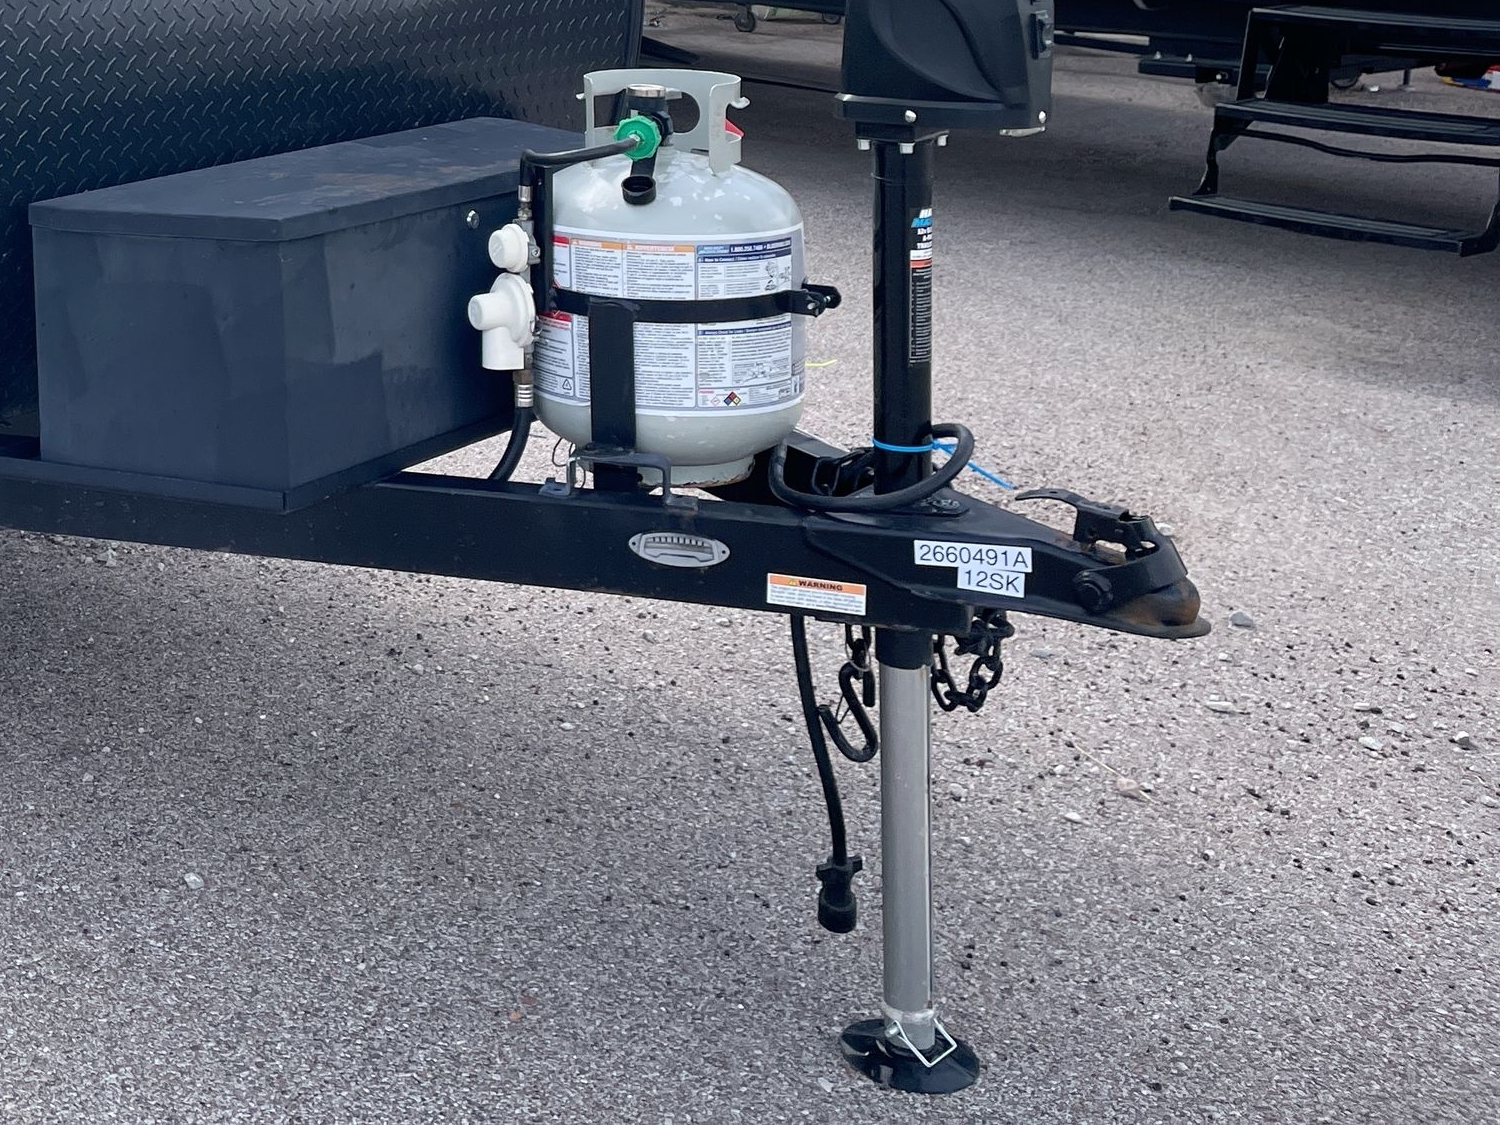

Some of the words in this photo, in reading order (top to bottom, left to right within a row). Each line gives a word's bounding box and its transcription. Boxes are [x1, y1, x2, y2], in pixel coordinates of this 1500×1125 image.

[919, 544, 1029, 569] 2660491A
[798, 579, 843, 592] WARNING
[965, 570, 1020, 594] 12SK
